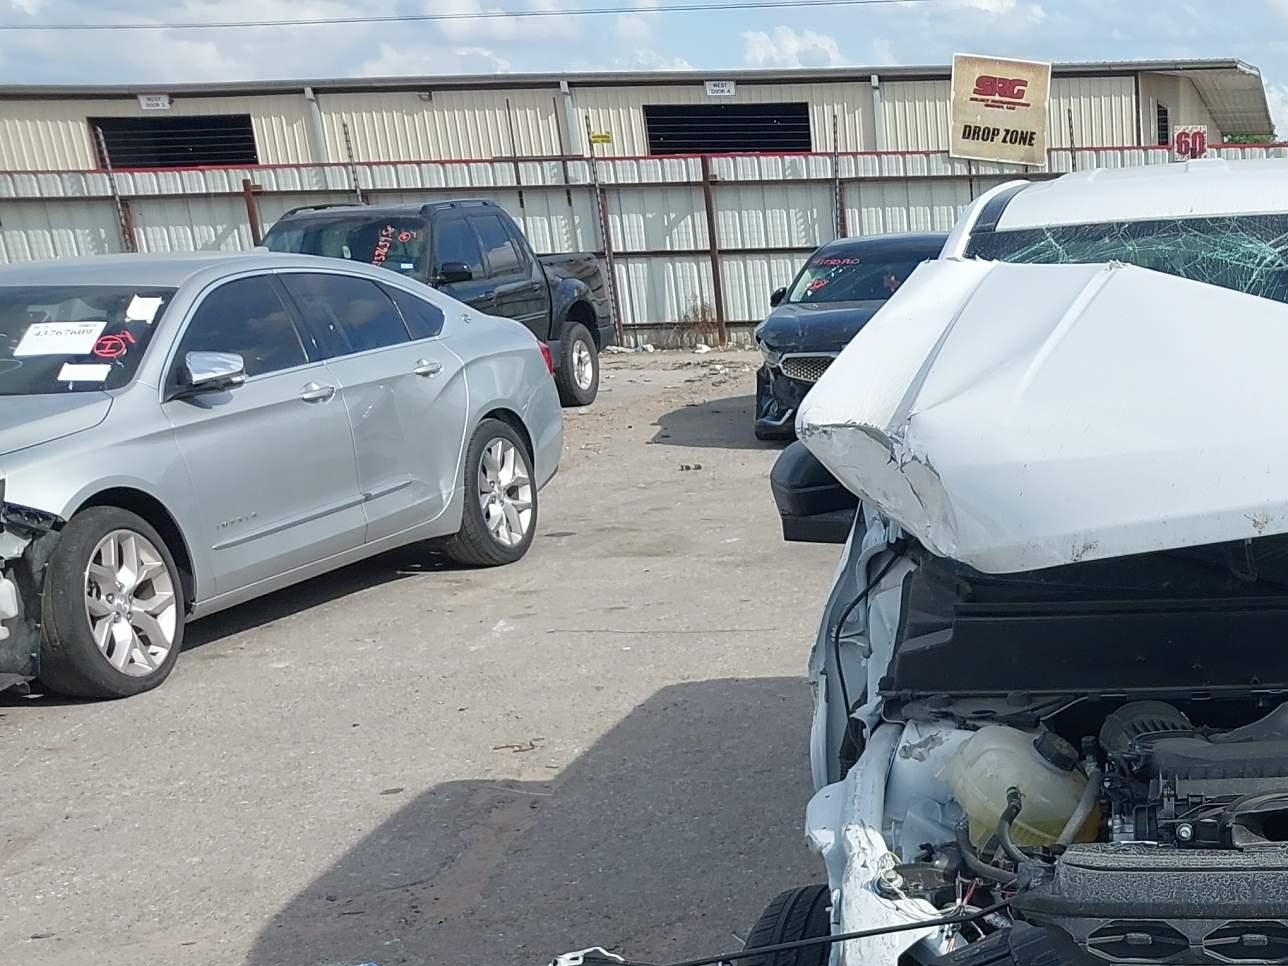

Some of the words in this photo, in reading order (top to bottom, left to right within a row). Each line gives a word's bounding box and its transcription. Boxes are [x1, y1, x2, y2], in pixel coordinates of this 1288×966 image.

[962, 125, 1000, 142] DROP
[1001, 129, 1037, 147] ZONE
[1176, 131, 1206, 156] 60
